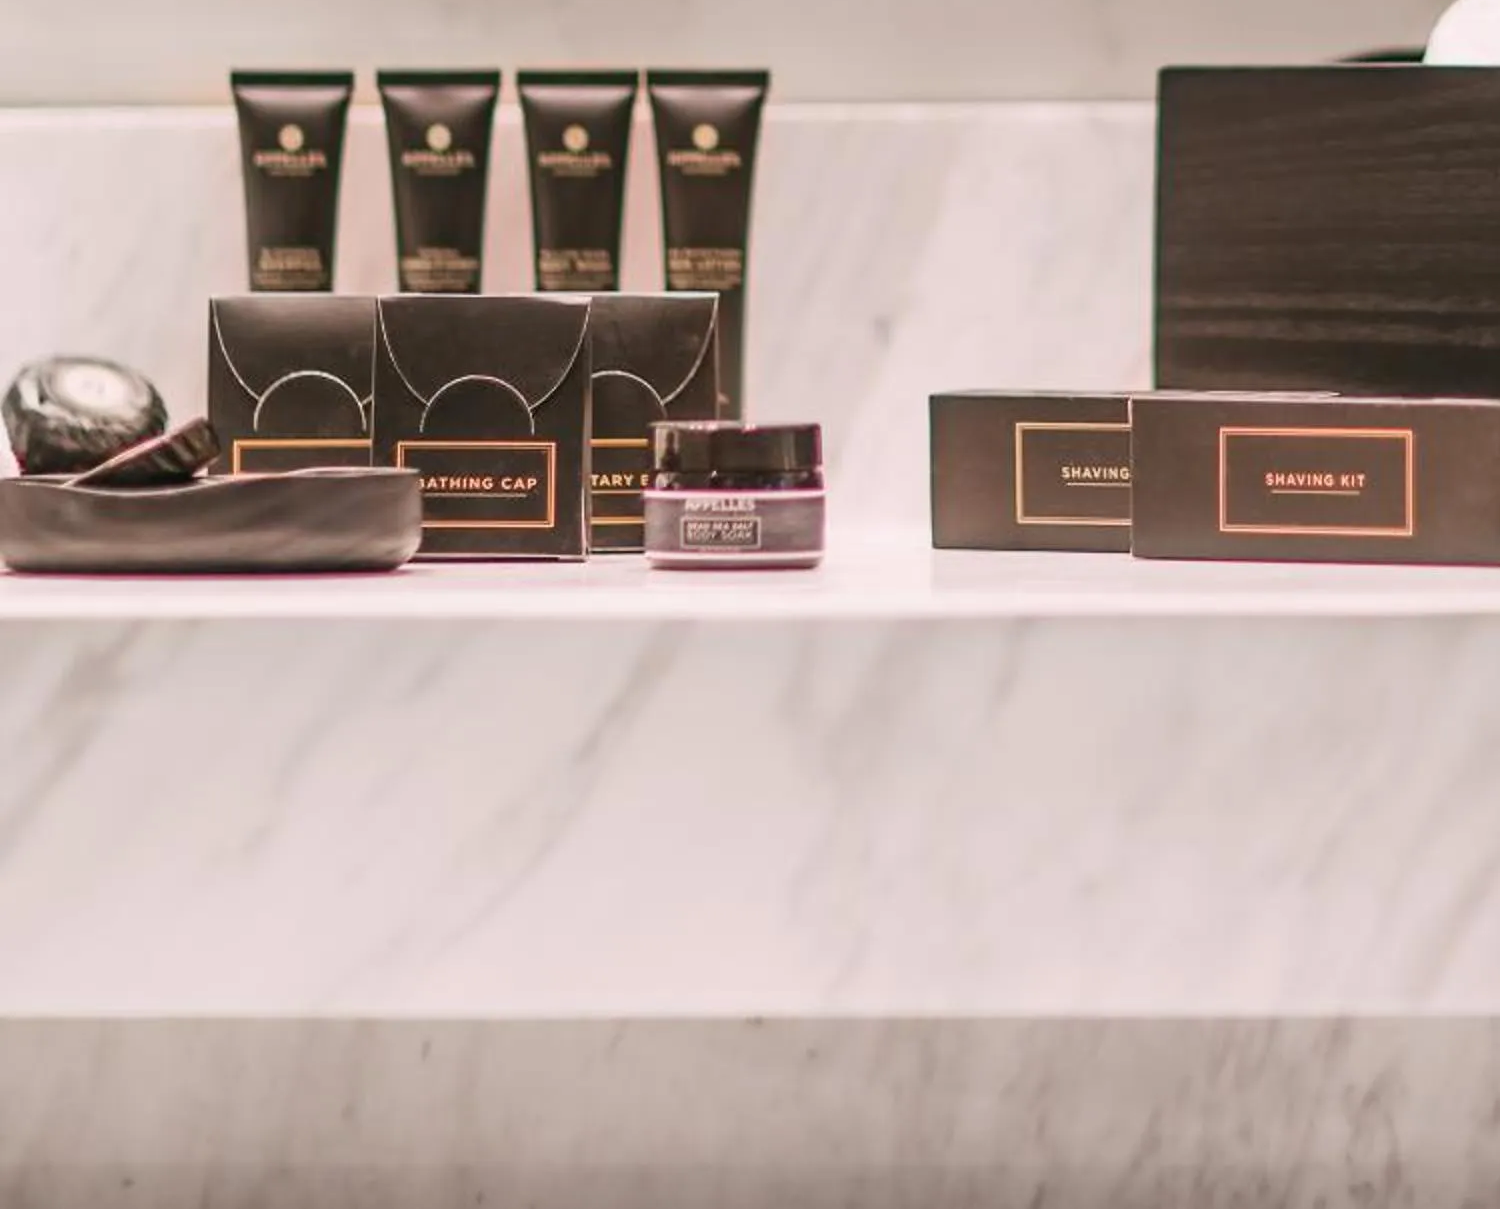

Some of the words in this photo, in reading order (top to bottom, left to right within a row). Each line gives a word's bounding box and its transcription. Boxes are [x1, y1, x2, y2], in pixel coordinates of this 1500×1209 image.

[1061, 466, 1130, 480] SHAVING
[1265, 472, 1335, 487] SHAVING
[1341, 473, 1366, 488] KIT
[501, 477, 538, 490] CAP
